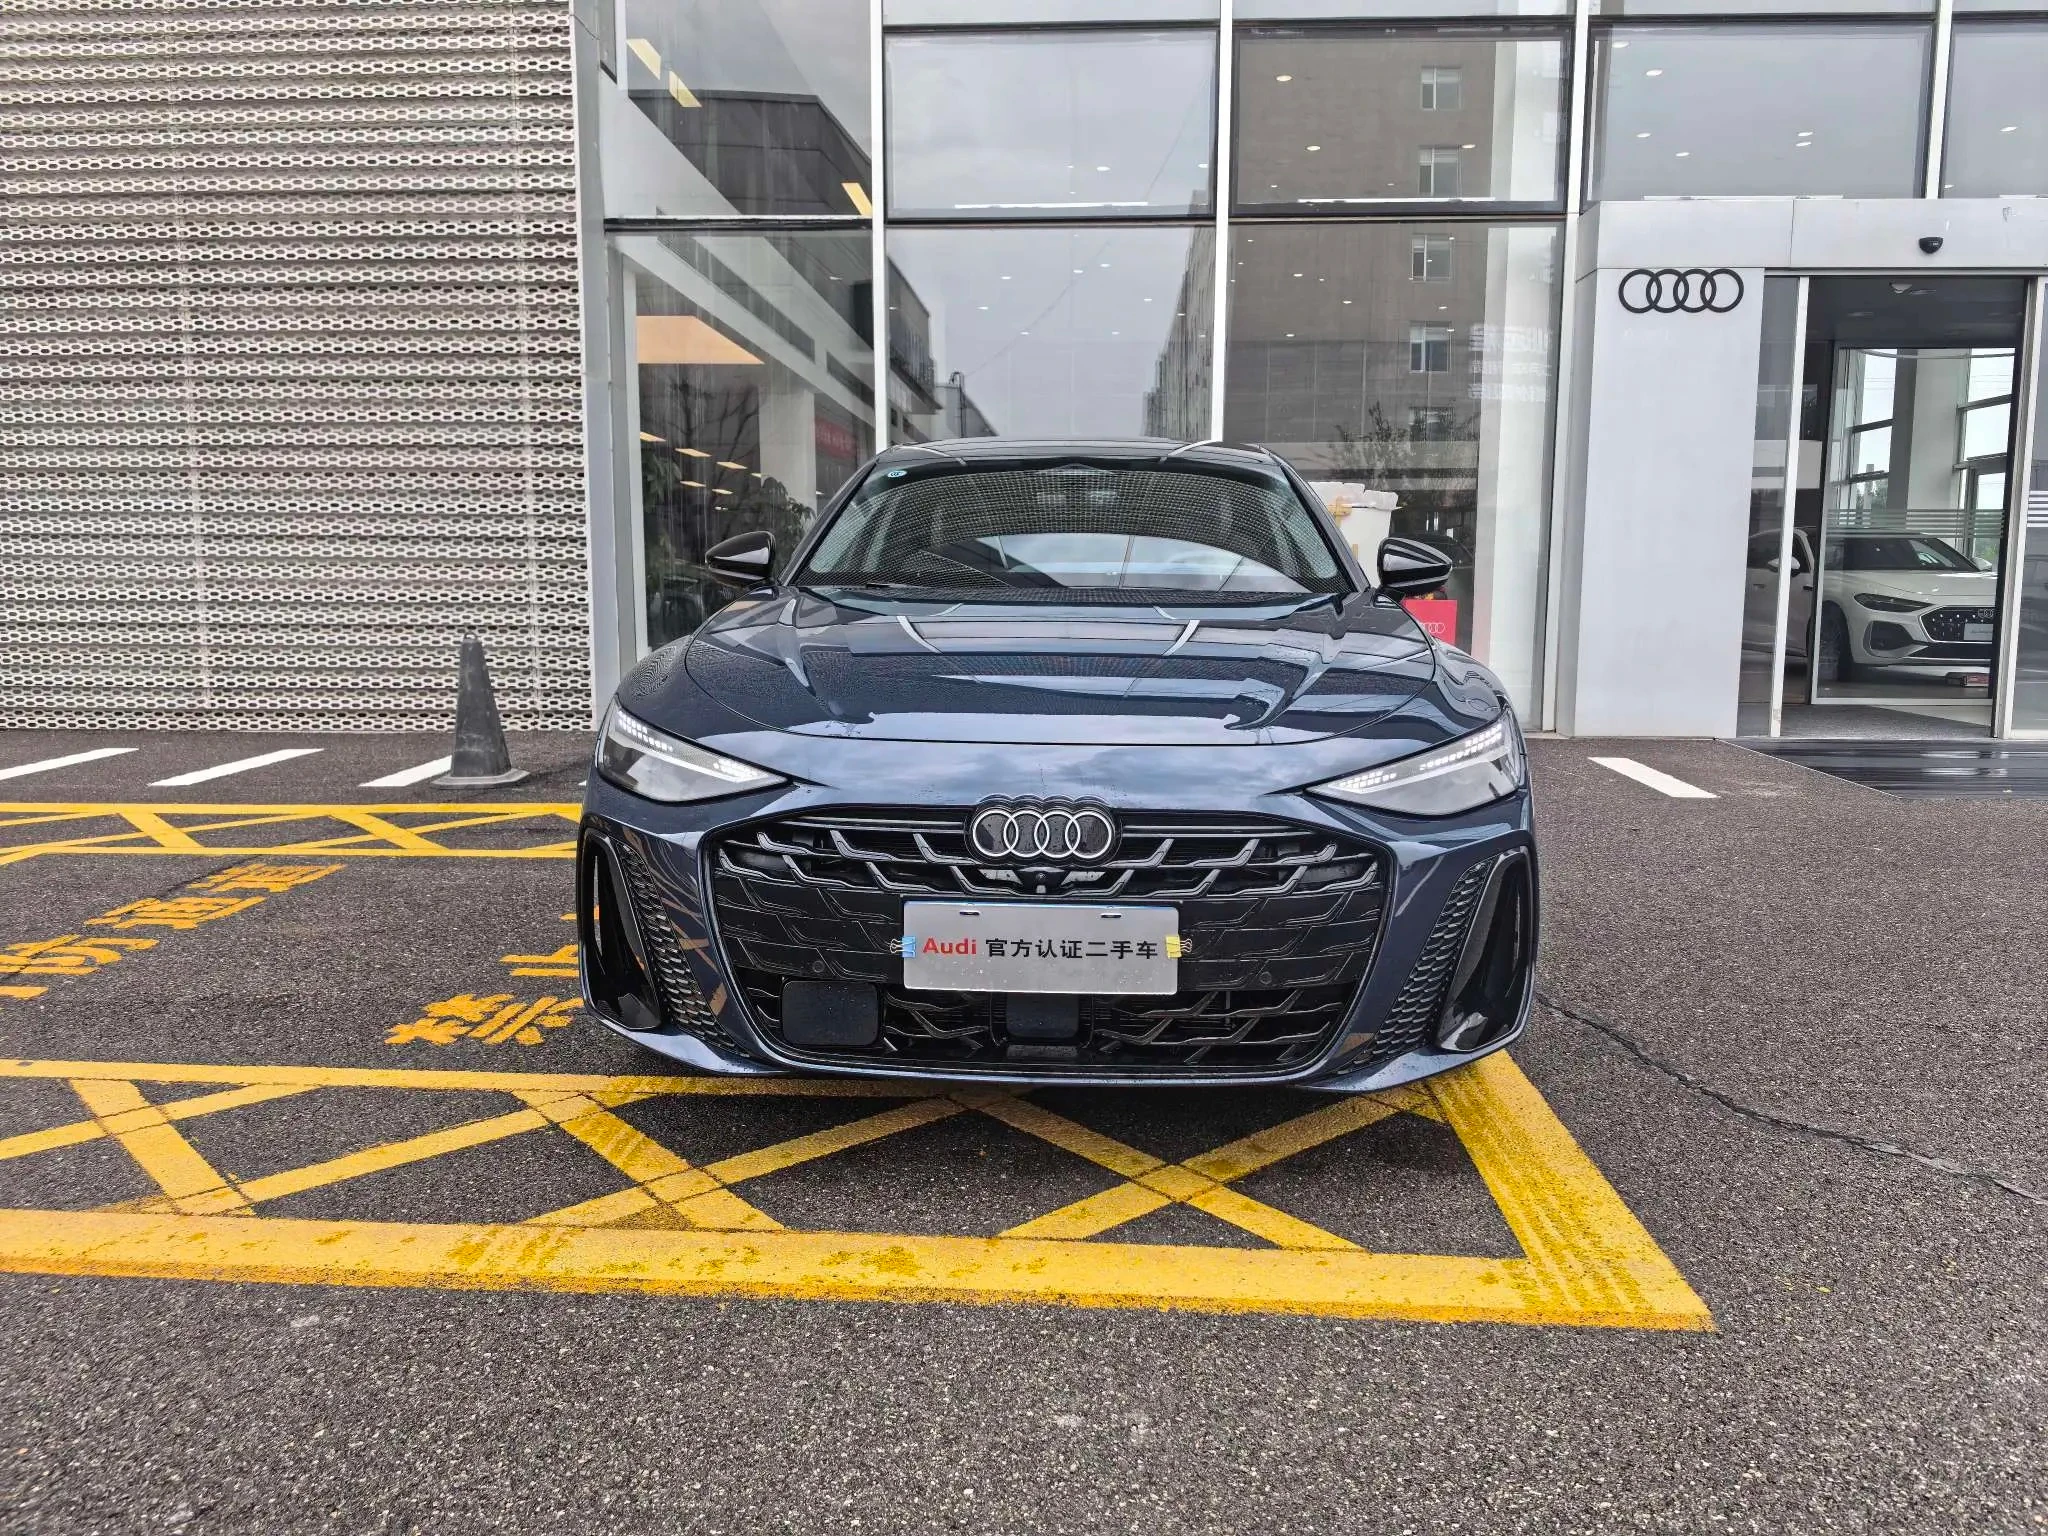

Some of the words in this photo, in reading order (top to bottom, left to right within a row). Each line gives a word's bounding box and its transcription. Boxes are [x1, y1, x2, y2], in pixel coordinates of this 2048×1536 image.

[0, 863, 346, 1000] 防通道
[384, 912, 584, 1046] 禁止
[923, 938, 977, 955] Audi
[985, 938, 1158, 960] 官方认证二手车
